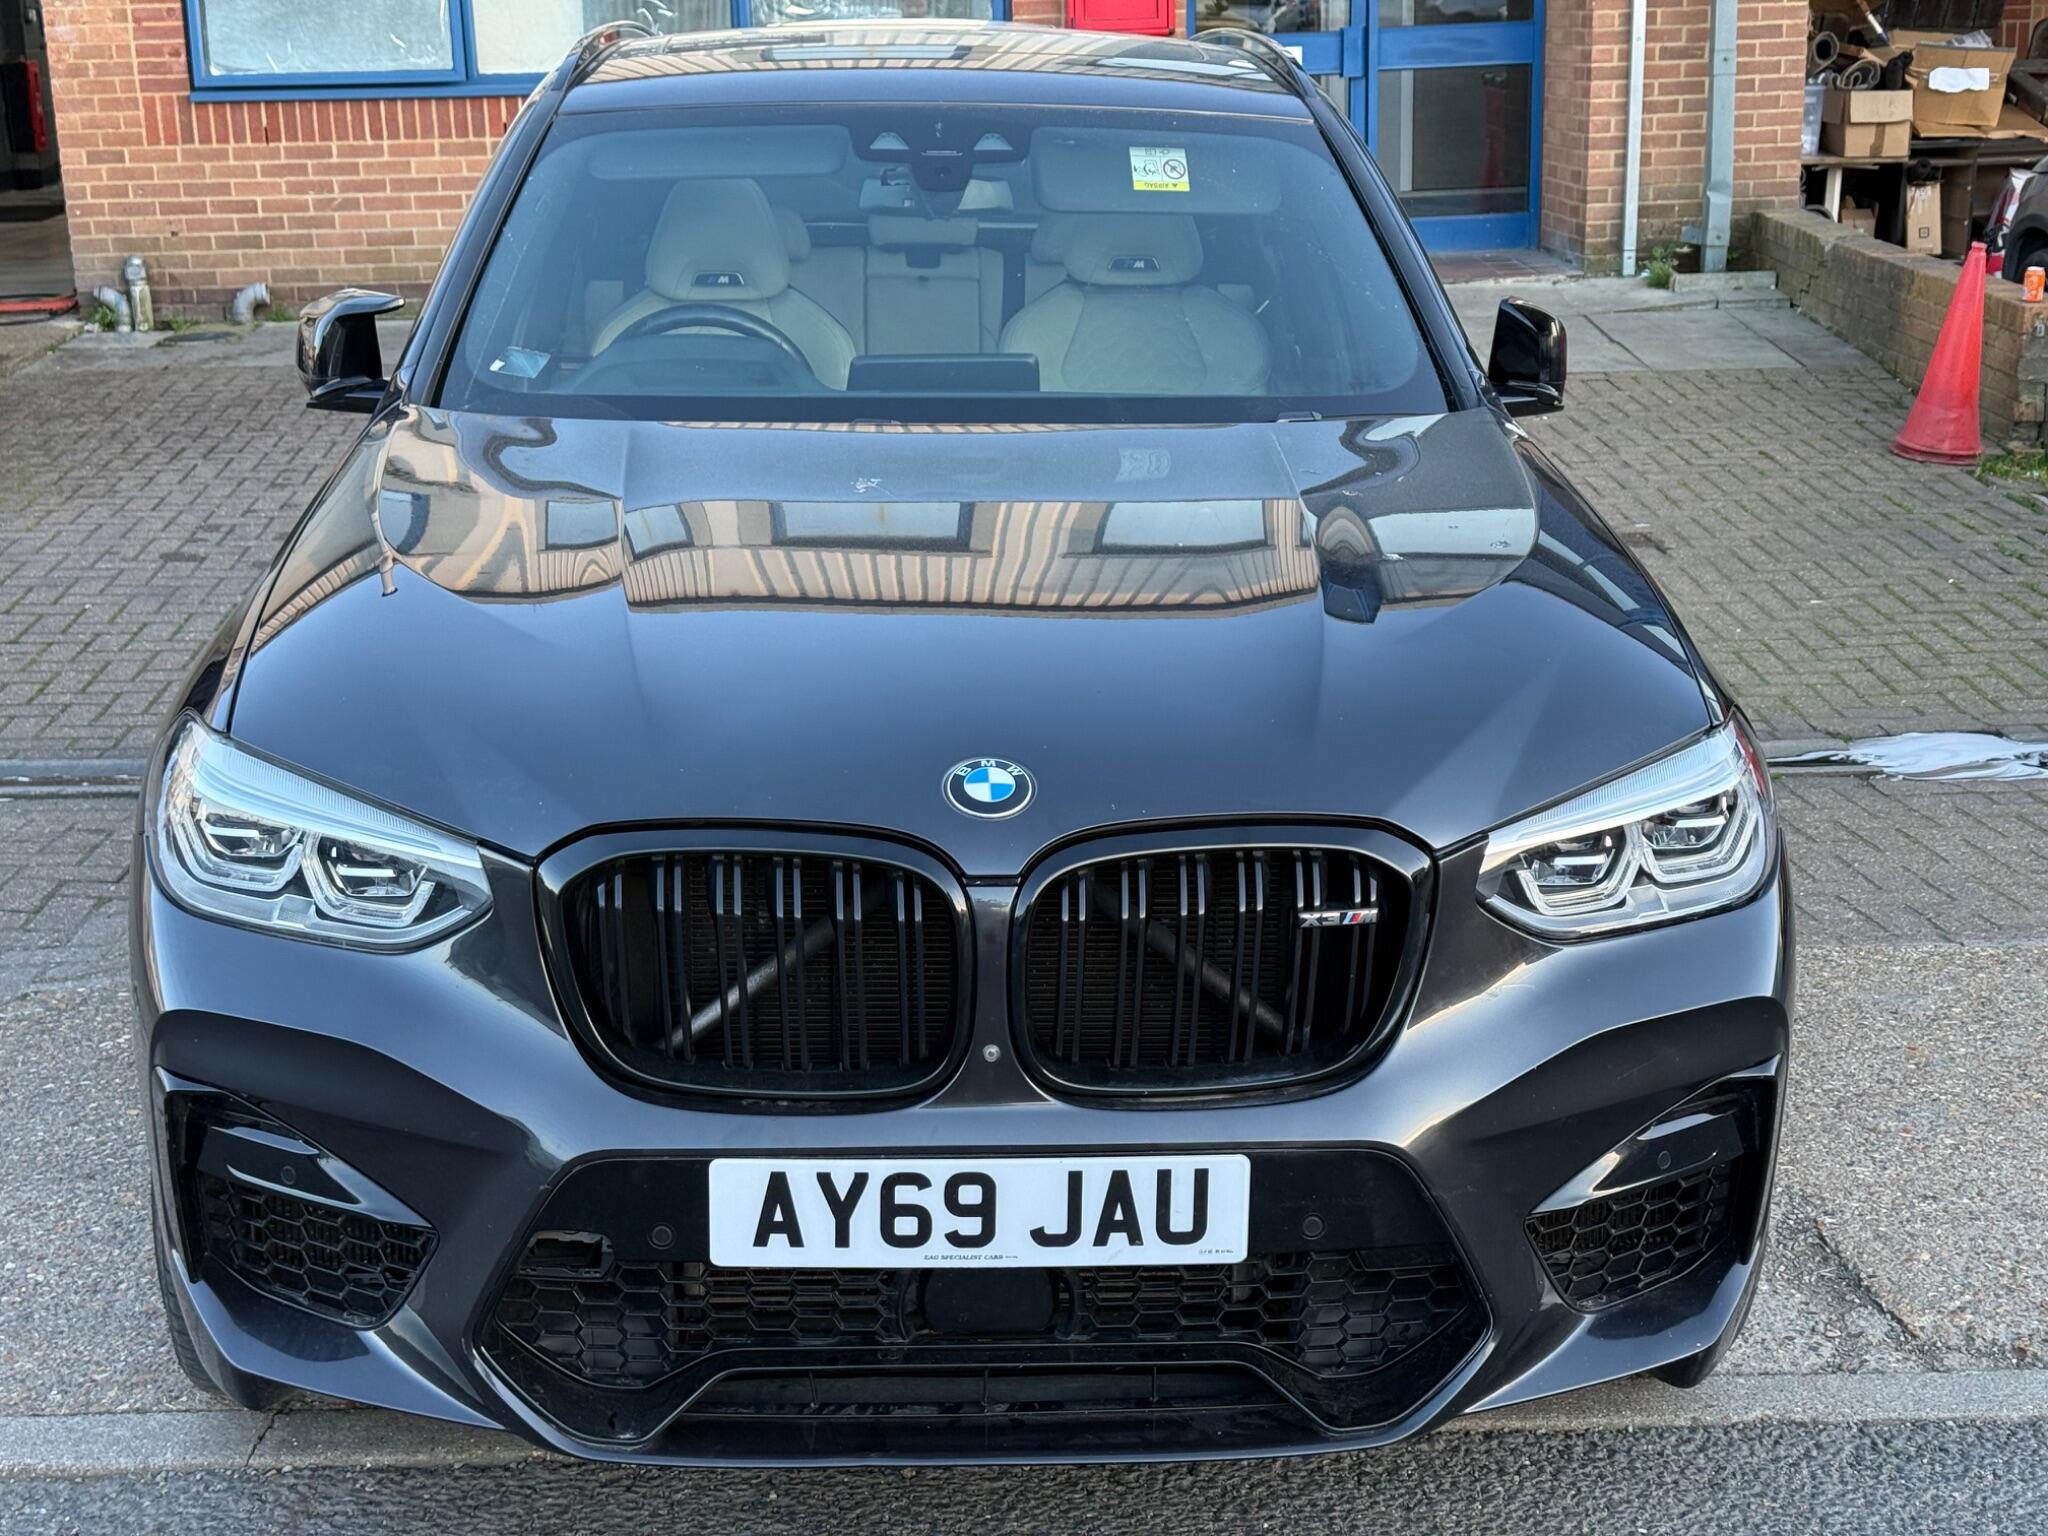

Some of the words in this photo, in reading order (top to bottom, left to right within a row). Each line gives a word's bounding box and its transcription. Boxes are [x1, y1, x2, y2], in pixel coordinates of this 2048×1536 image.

[955, 760, 1023, 777] BMW
[752, 1170, 997, 1249] AY69
[1029, 1168, 1210, 1248] JAU
